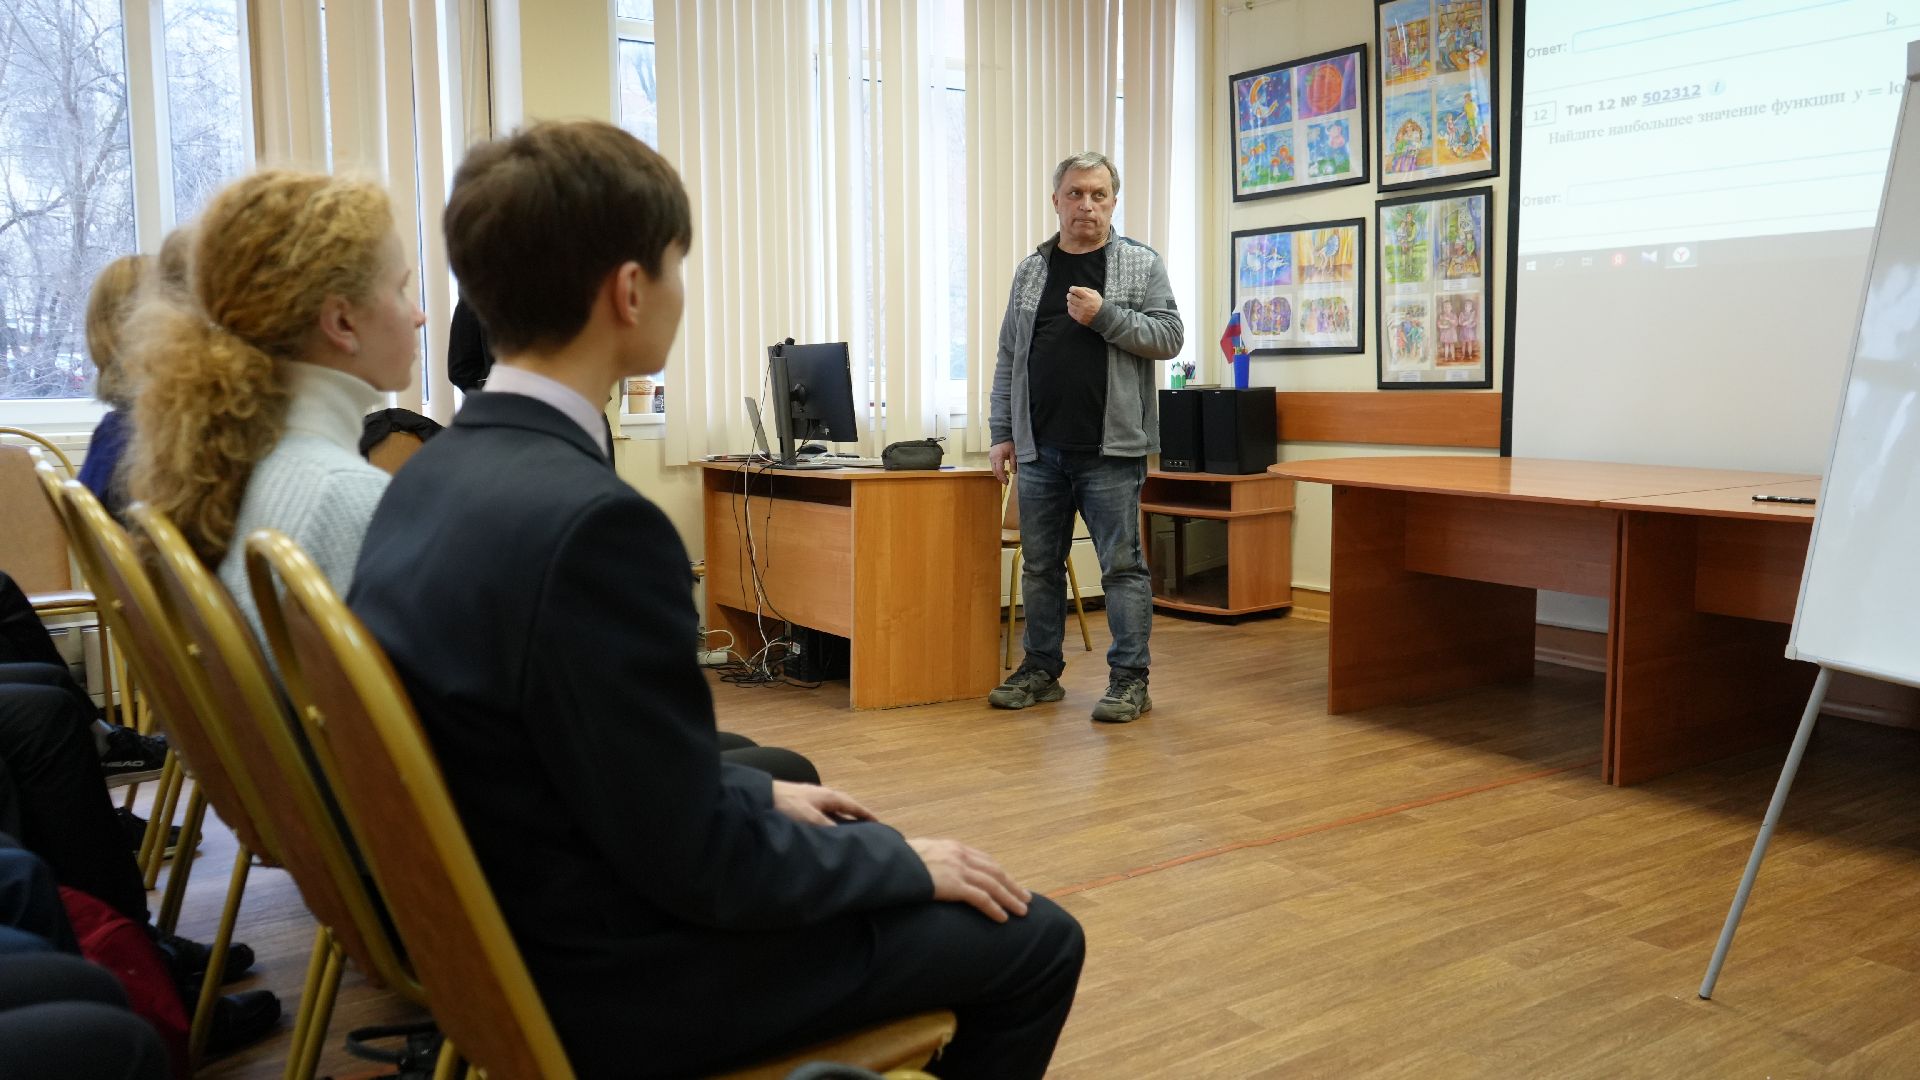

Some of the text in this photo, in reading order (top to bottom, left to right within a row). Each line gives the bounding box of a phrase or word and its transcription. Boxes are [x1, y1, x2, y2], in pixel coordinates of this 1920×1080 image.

[1526, 43, 1567, 58] Ответ:
[1566, 102, 1593, 117] Тип
[1598, 98, 1616, 111] 12
[1641, 84, 1702, 107] 502312
[1533, 109, 1548, 120] 12
[1548, 128, 1605, 144] Найдите
[1608, 114, 1693, 136] наибольшее
[1697, 102, 1767, 122] значение
[1771, 92, 1845, 116] функции
[1851, 89, 1863, 103] y
[1889, 80, 1905, 95] lo
[1521, 194, 1562, 208] Ответ:
